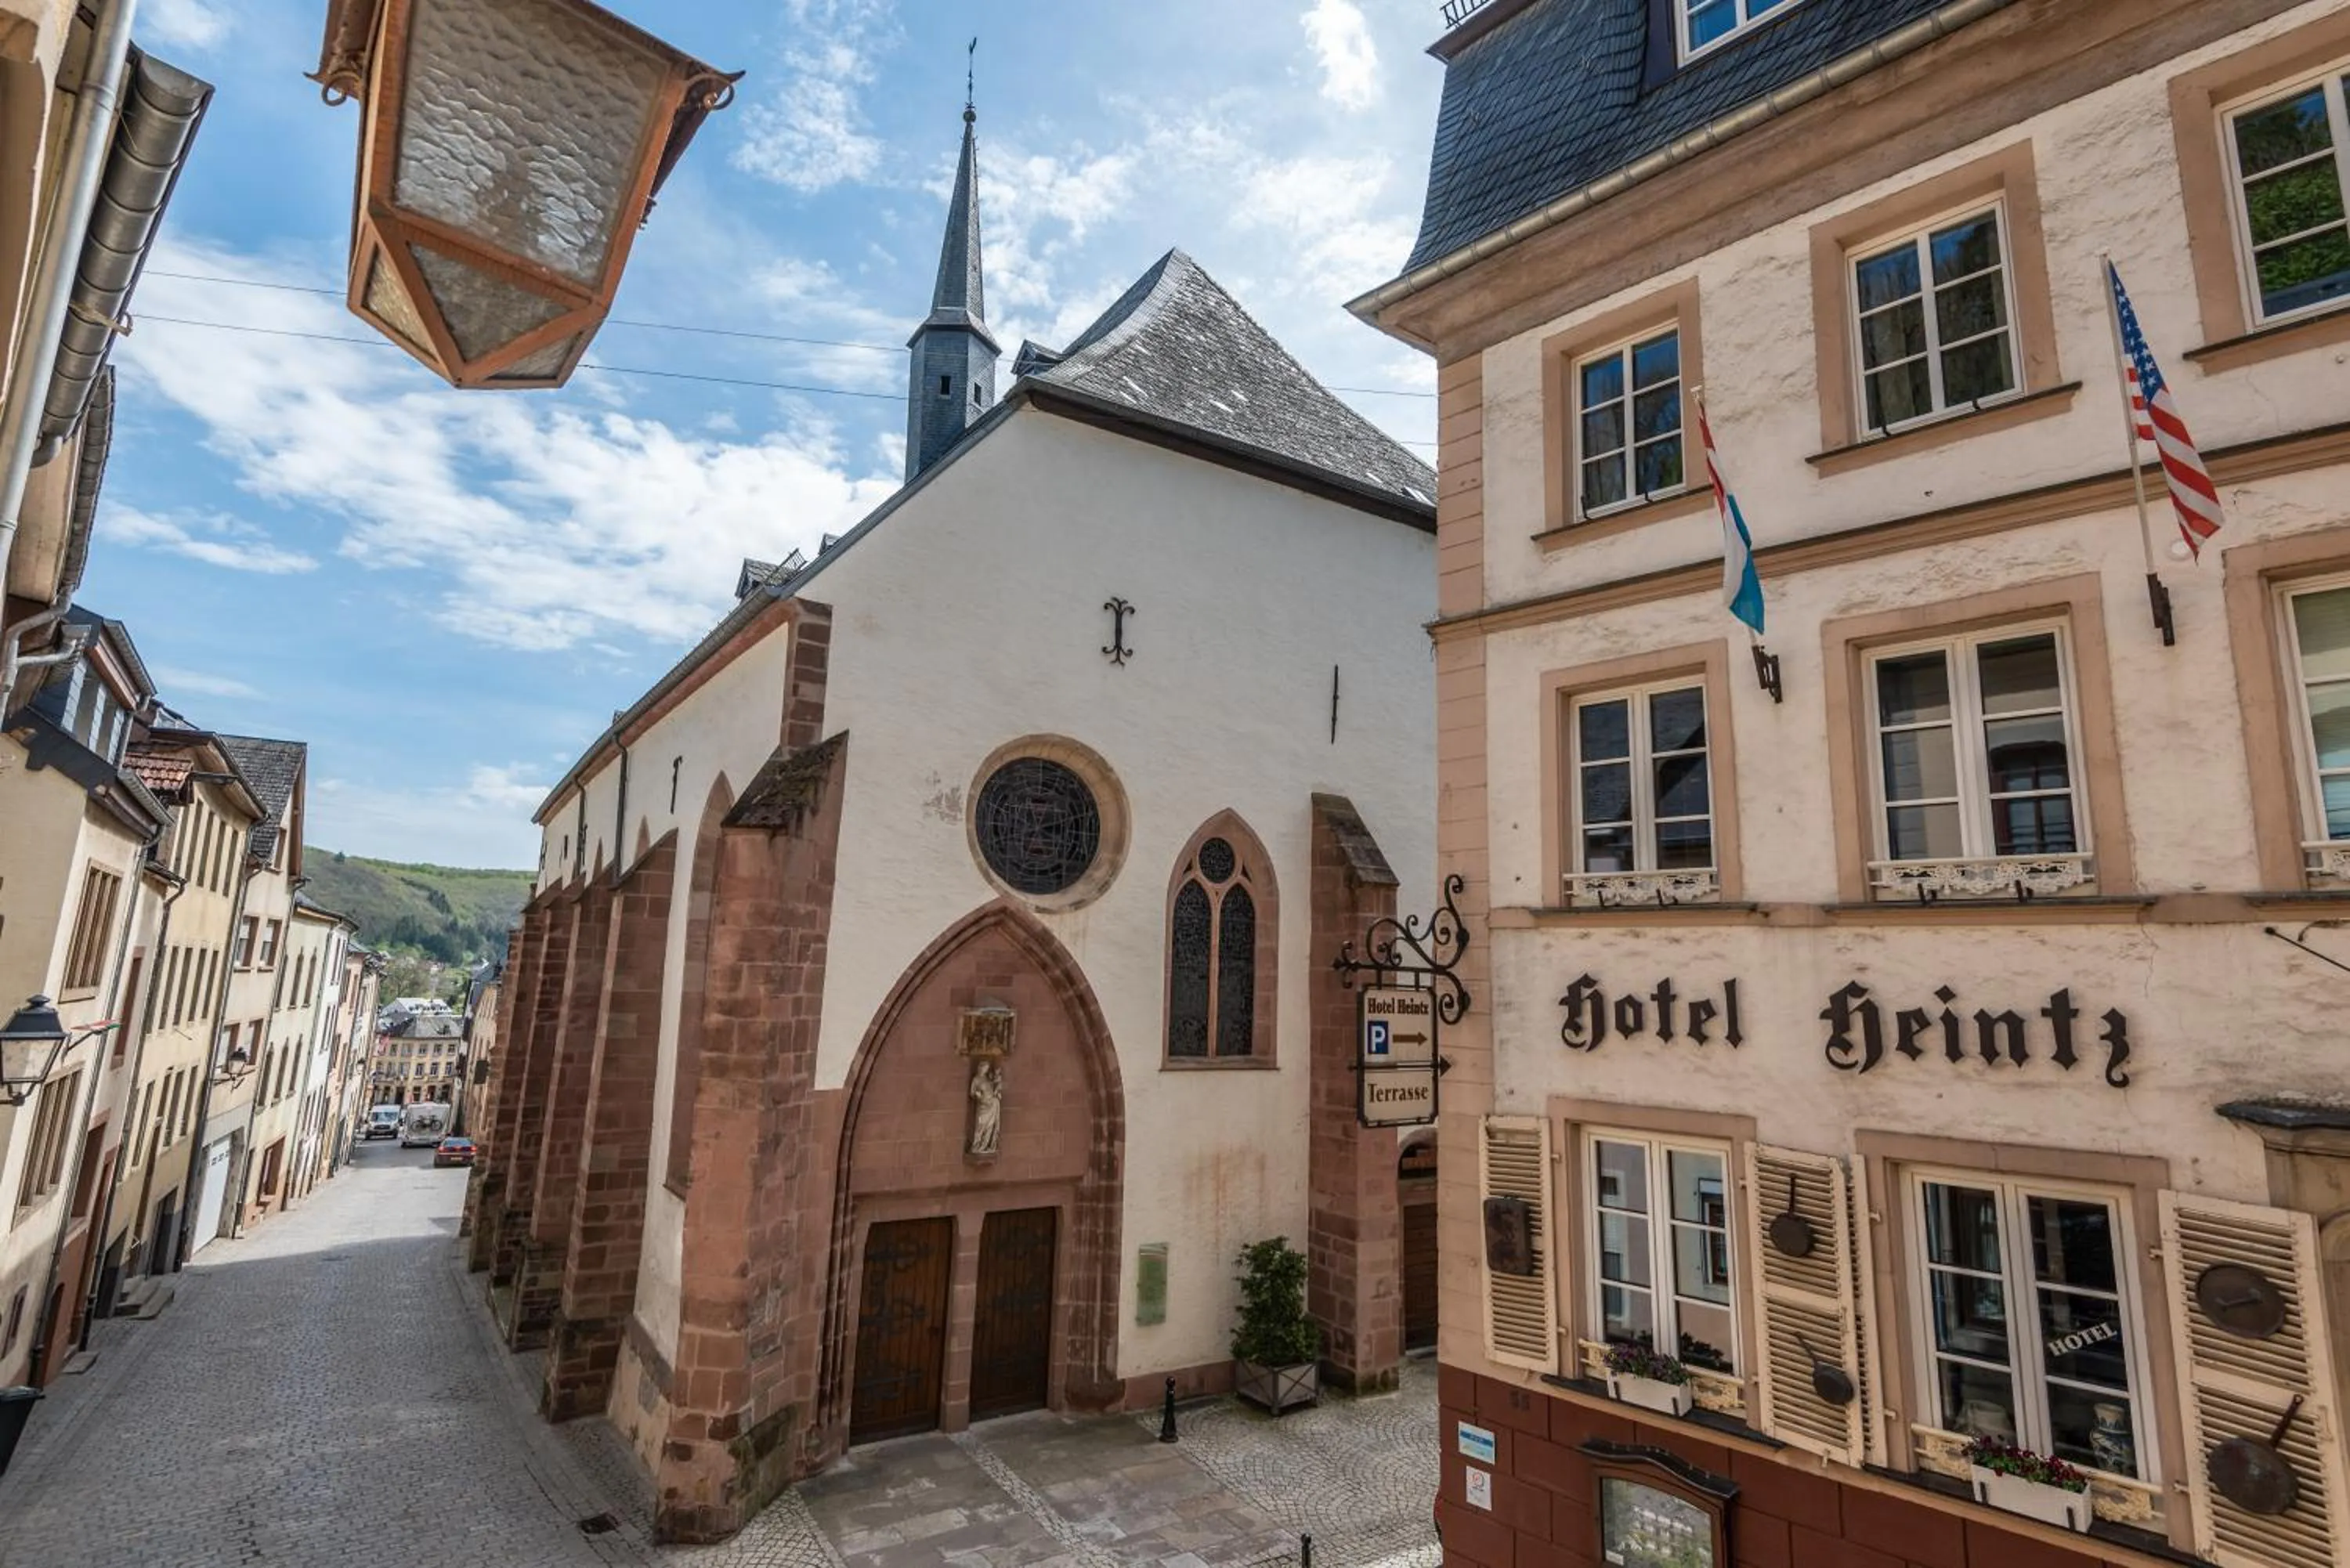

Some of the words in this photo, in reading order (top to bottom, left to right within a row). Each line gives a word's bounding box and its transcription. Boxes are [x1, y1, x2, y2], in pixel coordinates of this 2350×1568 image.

[1368, 997, 1394, 1014] Hotel
[1397, 998, 1430, 1015] Heintz
[1371, 1024, 1386, 1053] P
[1558, 973, 1743, 1053] Hotel
[1820, 980, 2130, 1088] Heintz
[1367, 1083, 1430, 1103] Terrasse
[2047, 1321, 2117, 1357] HOTEL
